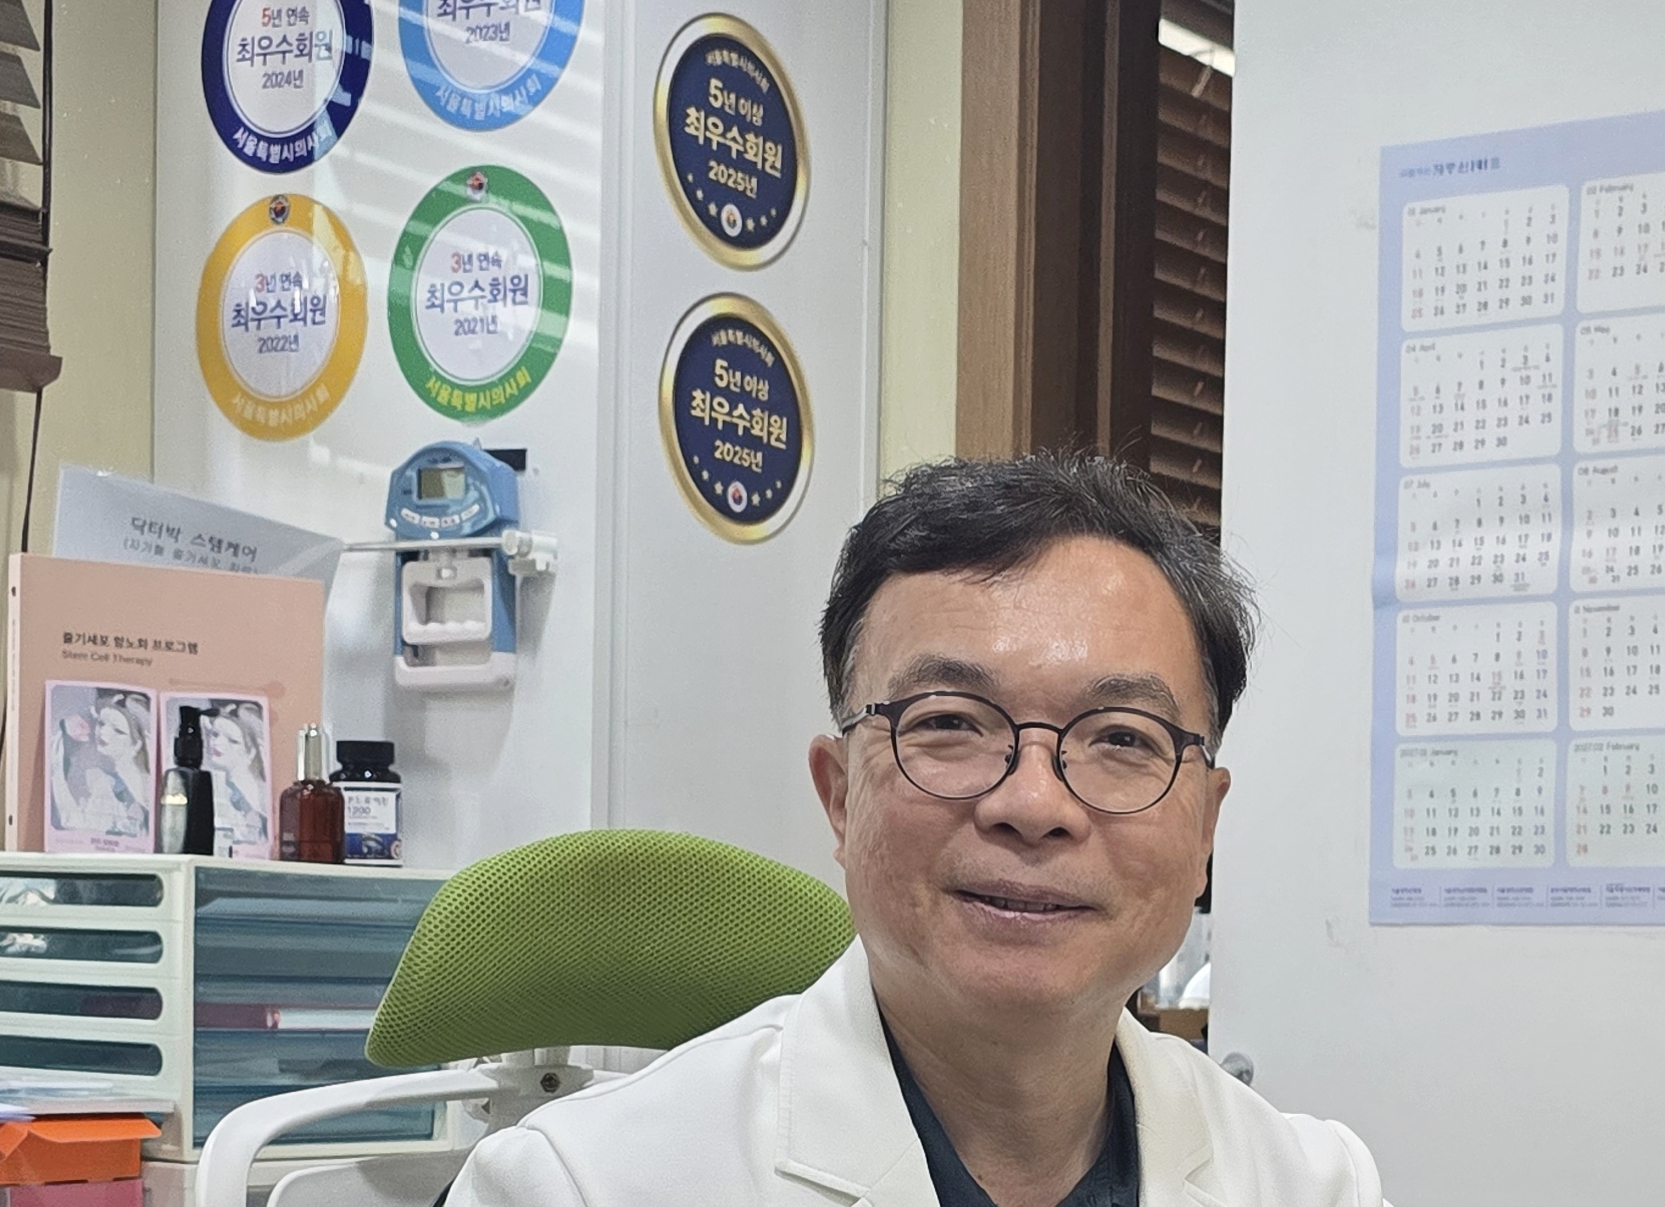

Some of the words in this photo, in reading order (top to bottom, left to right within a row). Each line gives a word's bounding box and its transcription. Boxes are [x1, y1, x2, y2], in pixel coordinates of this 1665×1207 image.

[262, 7, 282, 28] 5년
[286, 6, 310, 27] 연속
[465, 21, 510, 43] 2023년
[236, 29, 333, 67] 최우수회원
[262, 69, 304, 89] 2024년
[709, 77, 736, 115] 5년
[738, 97, 764, 126] 이상
[684, 106, 782, 178] 최우수회원
[708, 160, 757, 199] 2025년
[452, 252, 473, 273] 3년
[477, 251, 502, 271] 연속
[255, 273, 276, 293] 3년
[279, 271, 302, 291] 연속
[425, 274, 529, 314] 최우수회원
[231, 294, 327, 332] 최우수회원
[454, 315, 498, 336] 2021년
[257, 334, 299, 354] 2022년
[425, 366, 532, 413] 서울특별시의사회
[714, 358, 741, 393] 5년
[743, 375, 769, 401] 이상
[690, 388, 787, 449] 최우수회원
[714, 439, 762, 473] 2025년
[131, 516, 181, 543] 닥터박
